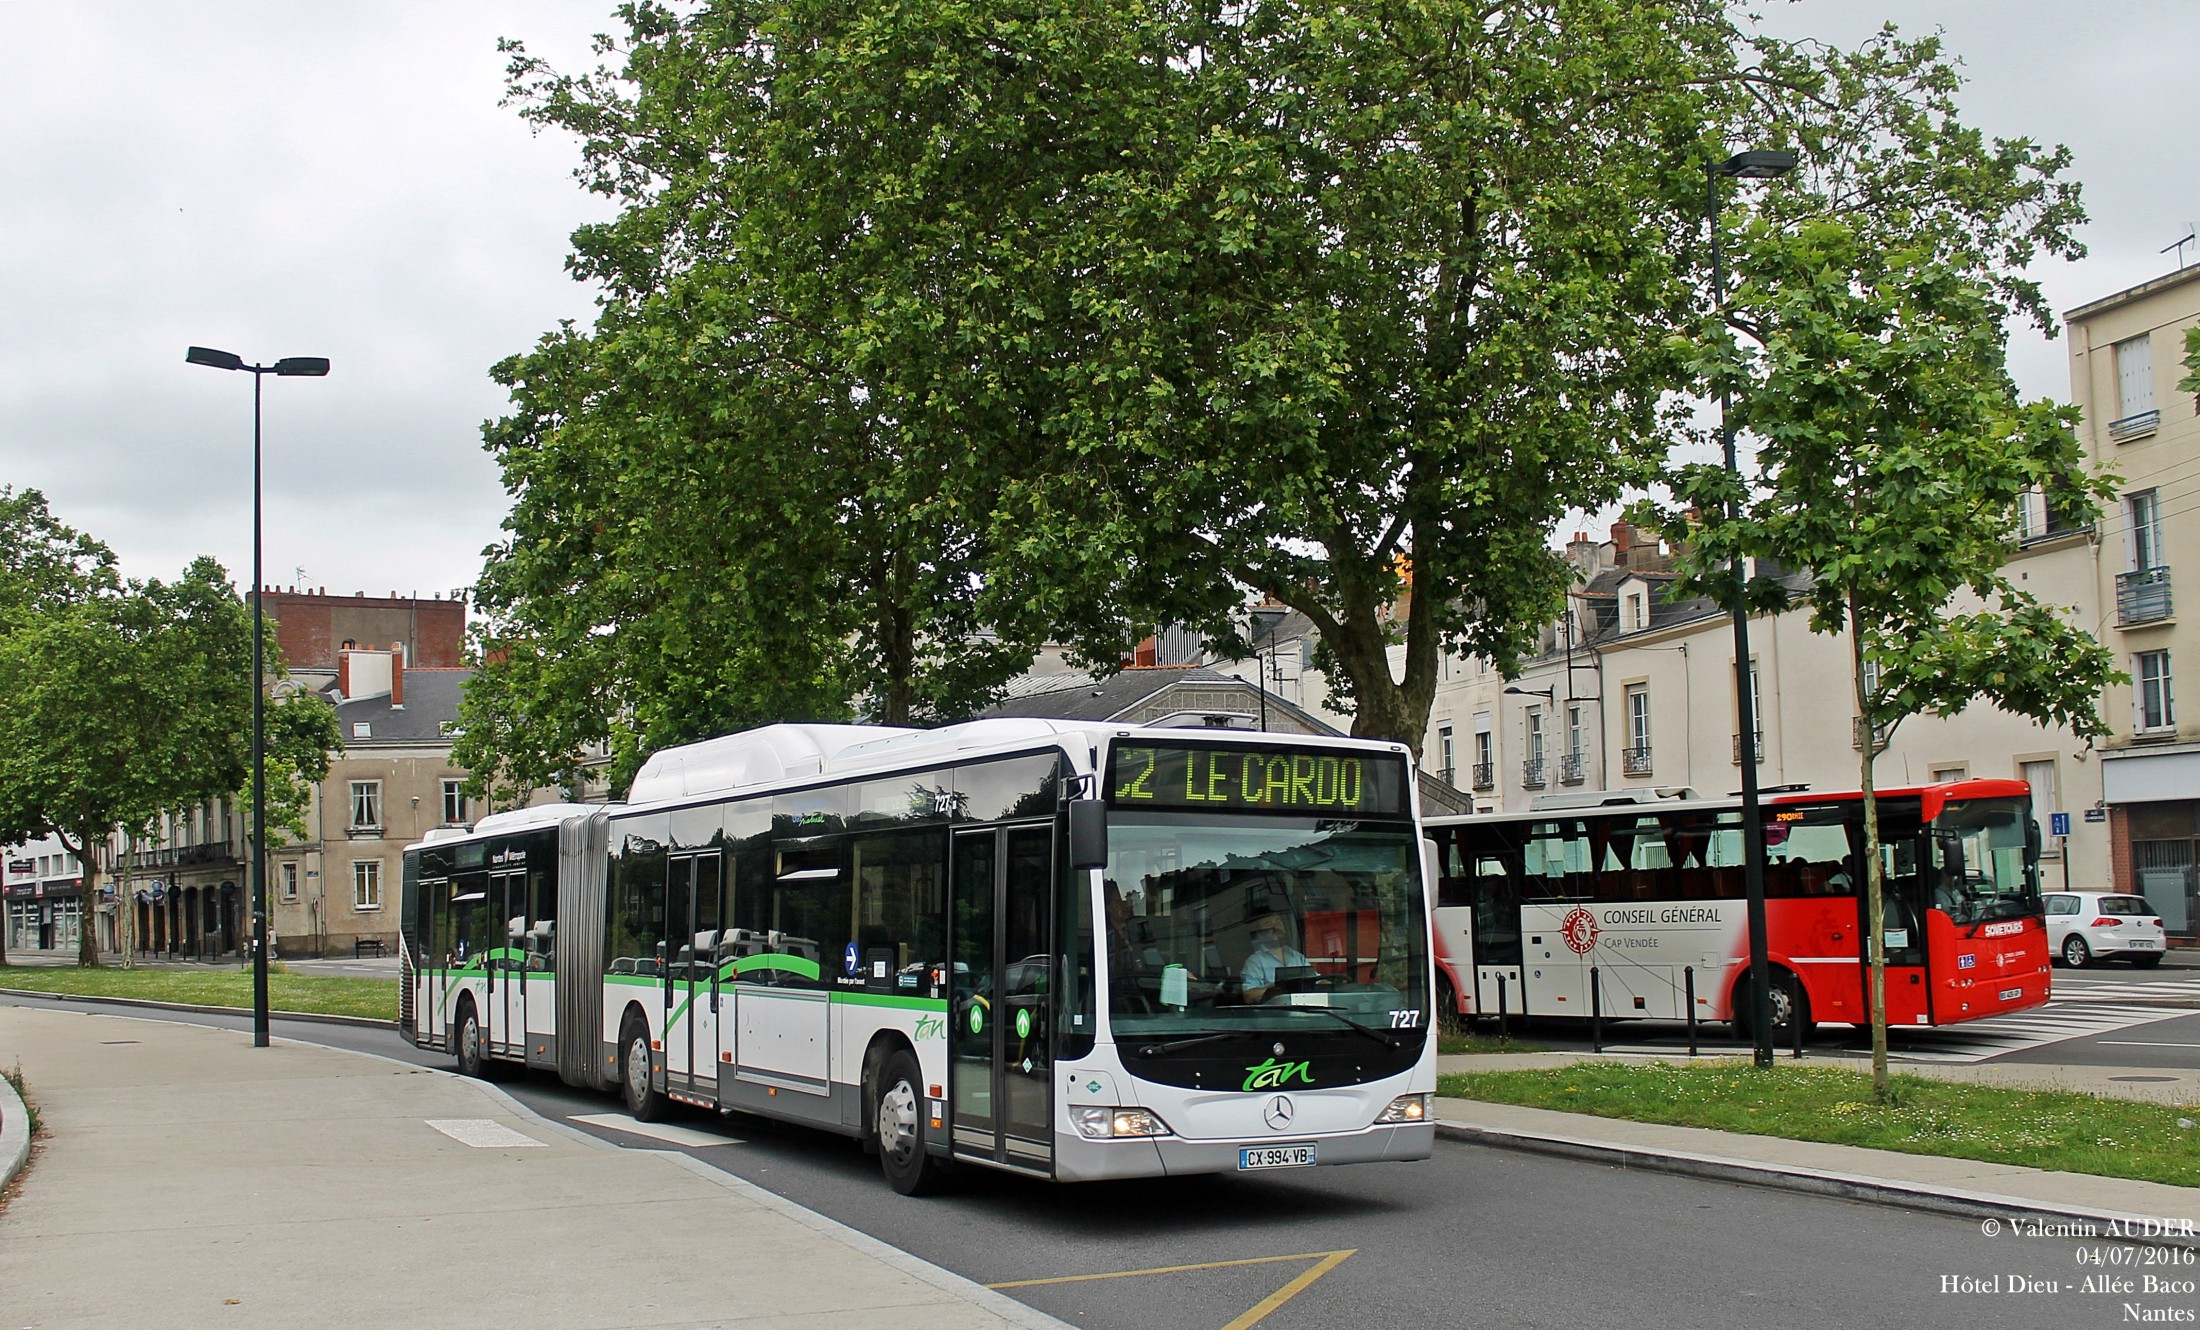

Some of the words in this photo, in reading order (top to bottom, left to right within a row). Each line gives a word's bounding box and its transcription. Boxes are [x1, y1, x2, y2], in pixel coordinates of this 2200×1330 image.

[1186, 751, 1229, 801] LE
[1241, 752, 1362, 806] CARDO
[934, 794, 951, 813] 727
[1603, 909, 1657, 924] CONSEIL
[1660, 906, 1722, 923] GÉNÉRAL
[1985, 920, 2024, 938] SOVETOURS
[914, 1014, 947, 1041] tan
[1389, 1010, 1420, 1029] 727
[1242, 1058, 1315, 1092] tan
